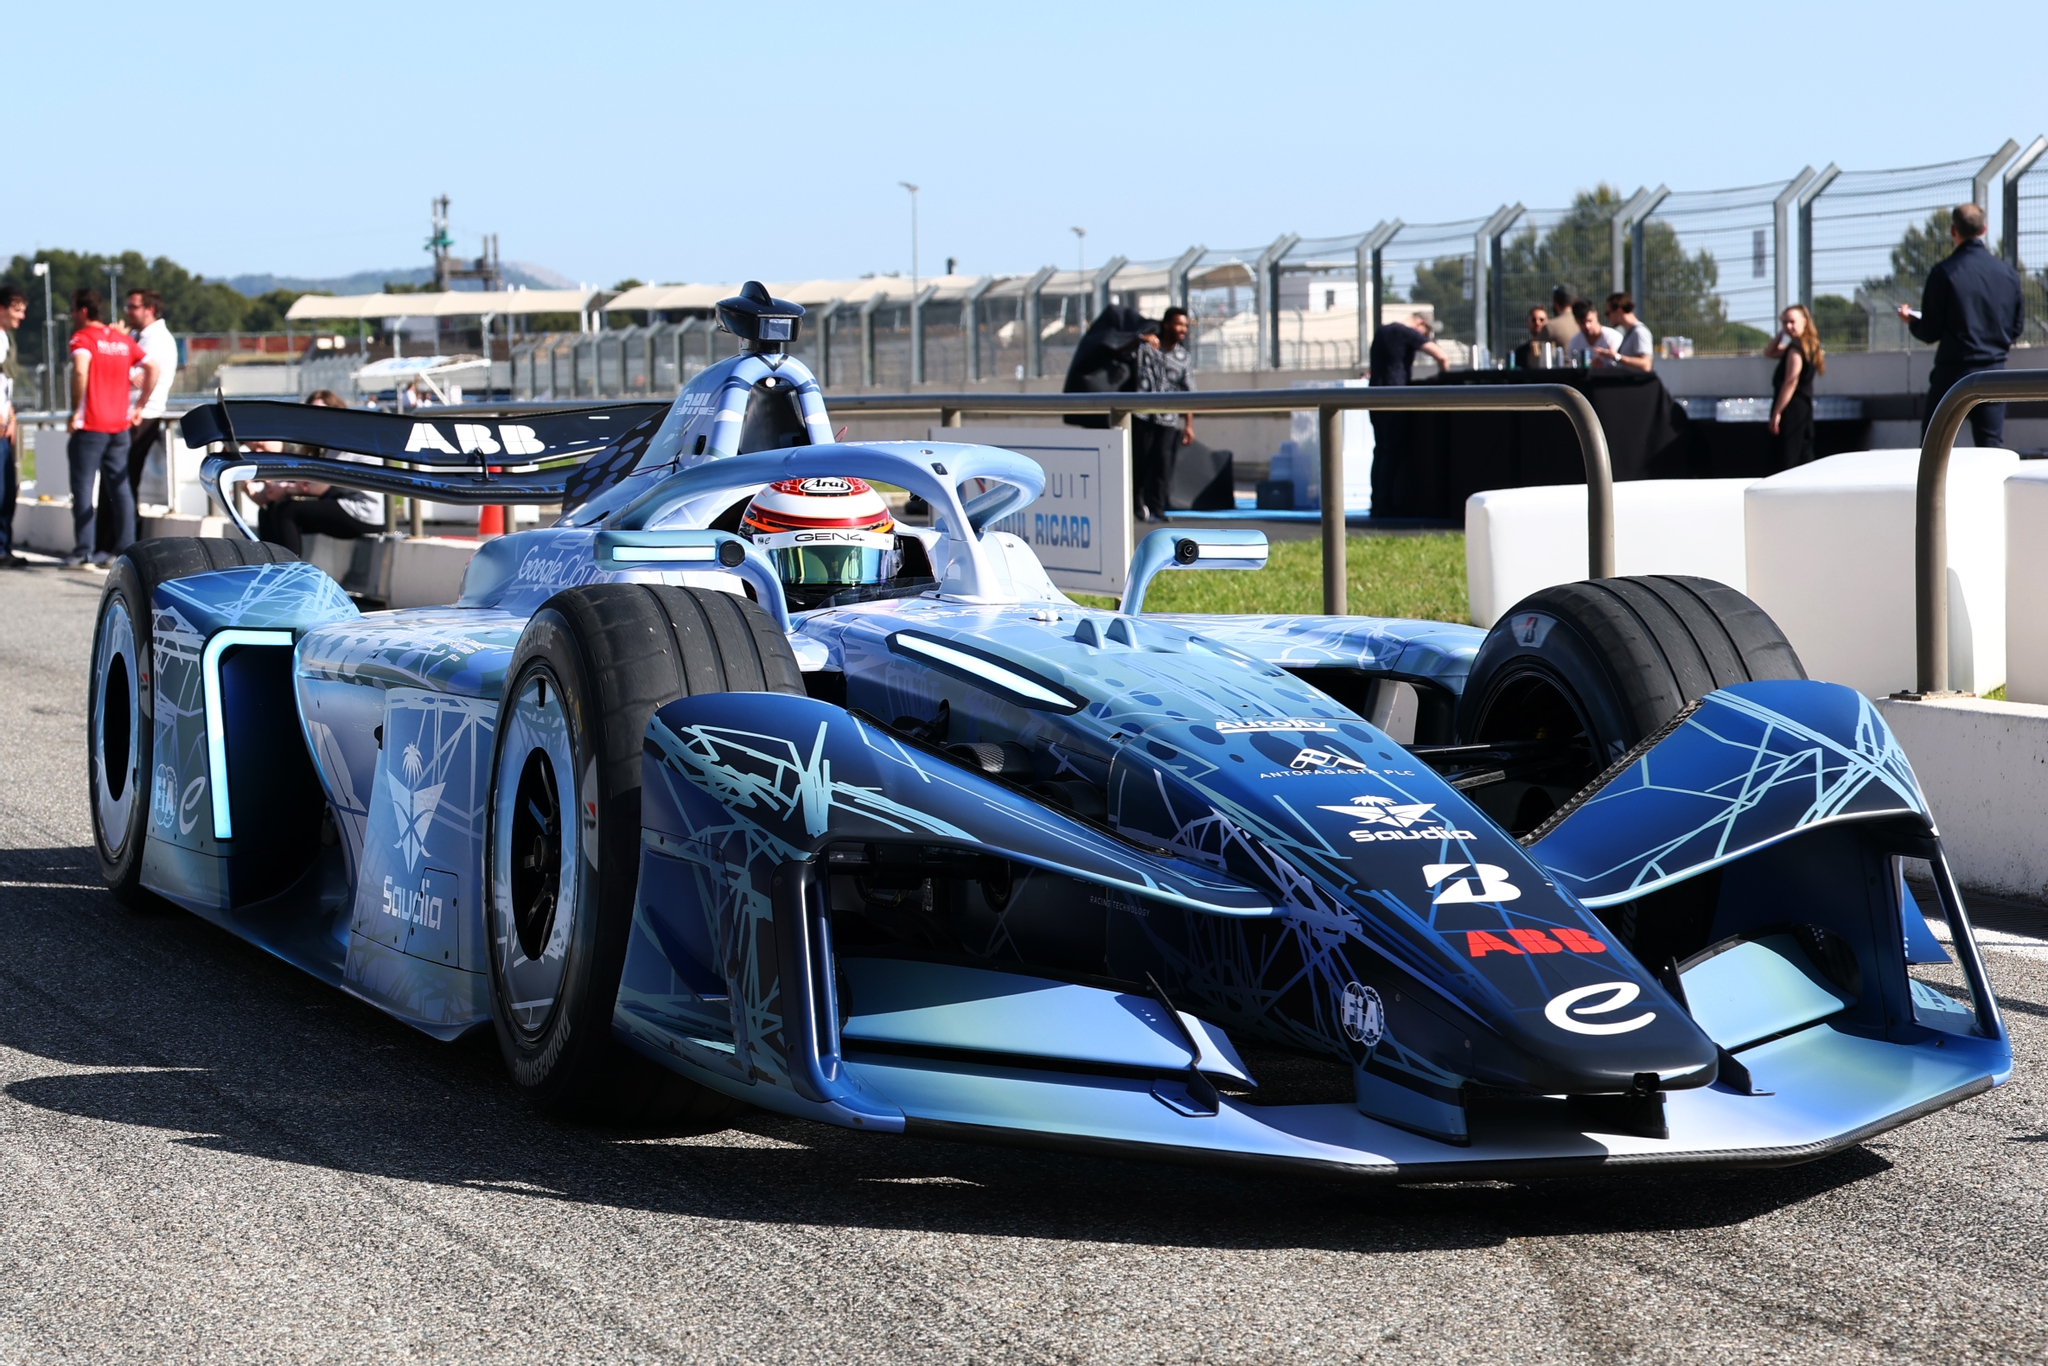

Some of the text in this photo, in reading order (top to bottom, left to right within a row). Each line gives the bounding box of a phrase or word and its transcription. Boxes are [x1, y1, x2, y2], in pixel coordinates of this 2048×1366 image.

[404, 423, 546, 455] ABB
[811, 479, 845, 489] Arai
[794, 532, 865, 542] GEN4
[1035, 513, 1091, 549] RICARD
[518, 545, 564, 592] Google
[1215, 719, 1326, 730] Autoliv
[1260, 769, 1416, 779] ANTOFAGASTA PLC
[1348, 826, 1478, 842] Saudia
[382, 875, 443, 931] Saudia
[1089, 895, 1151, 917] RACING TECHNOLOGY
[1466, 928, 1607, 957] ABB
